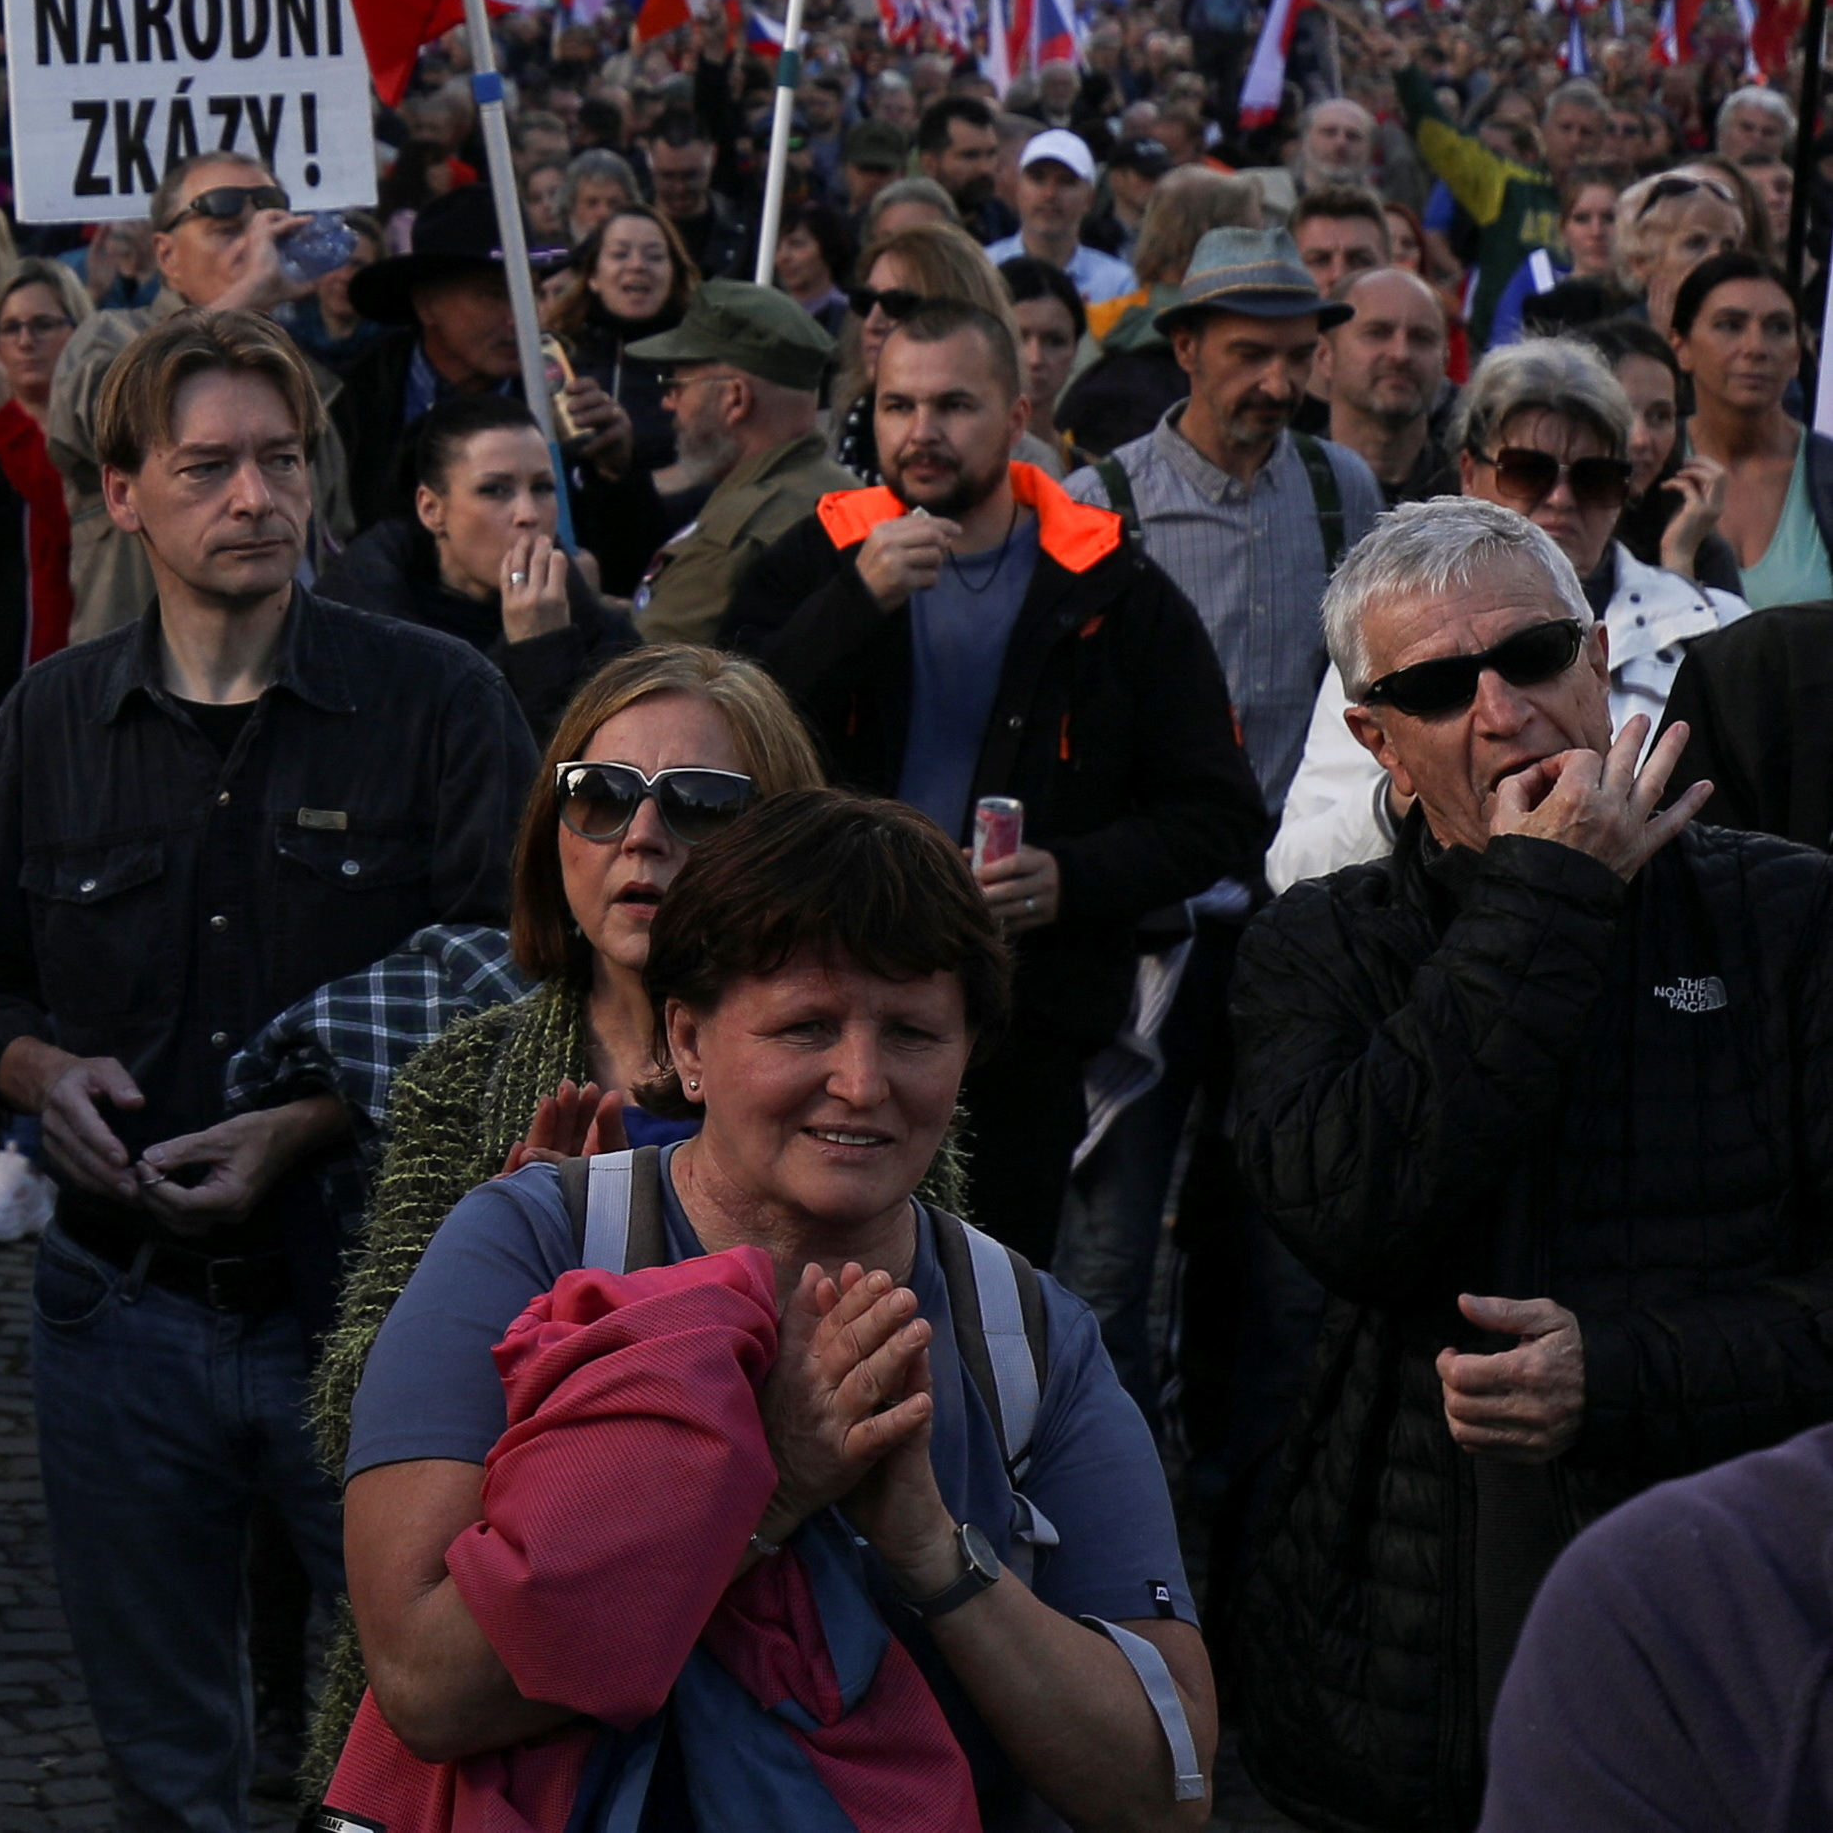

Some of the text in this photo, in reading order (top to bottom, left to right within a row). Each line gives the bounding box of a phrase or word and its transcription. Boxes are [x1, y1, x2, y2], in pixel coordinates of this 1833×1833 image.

[1677, 976, 1707, 991] THE
[1653, 985, 1708, 1002] NORTH
[1669, 998, 1707, 1014] FACE
